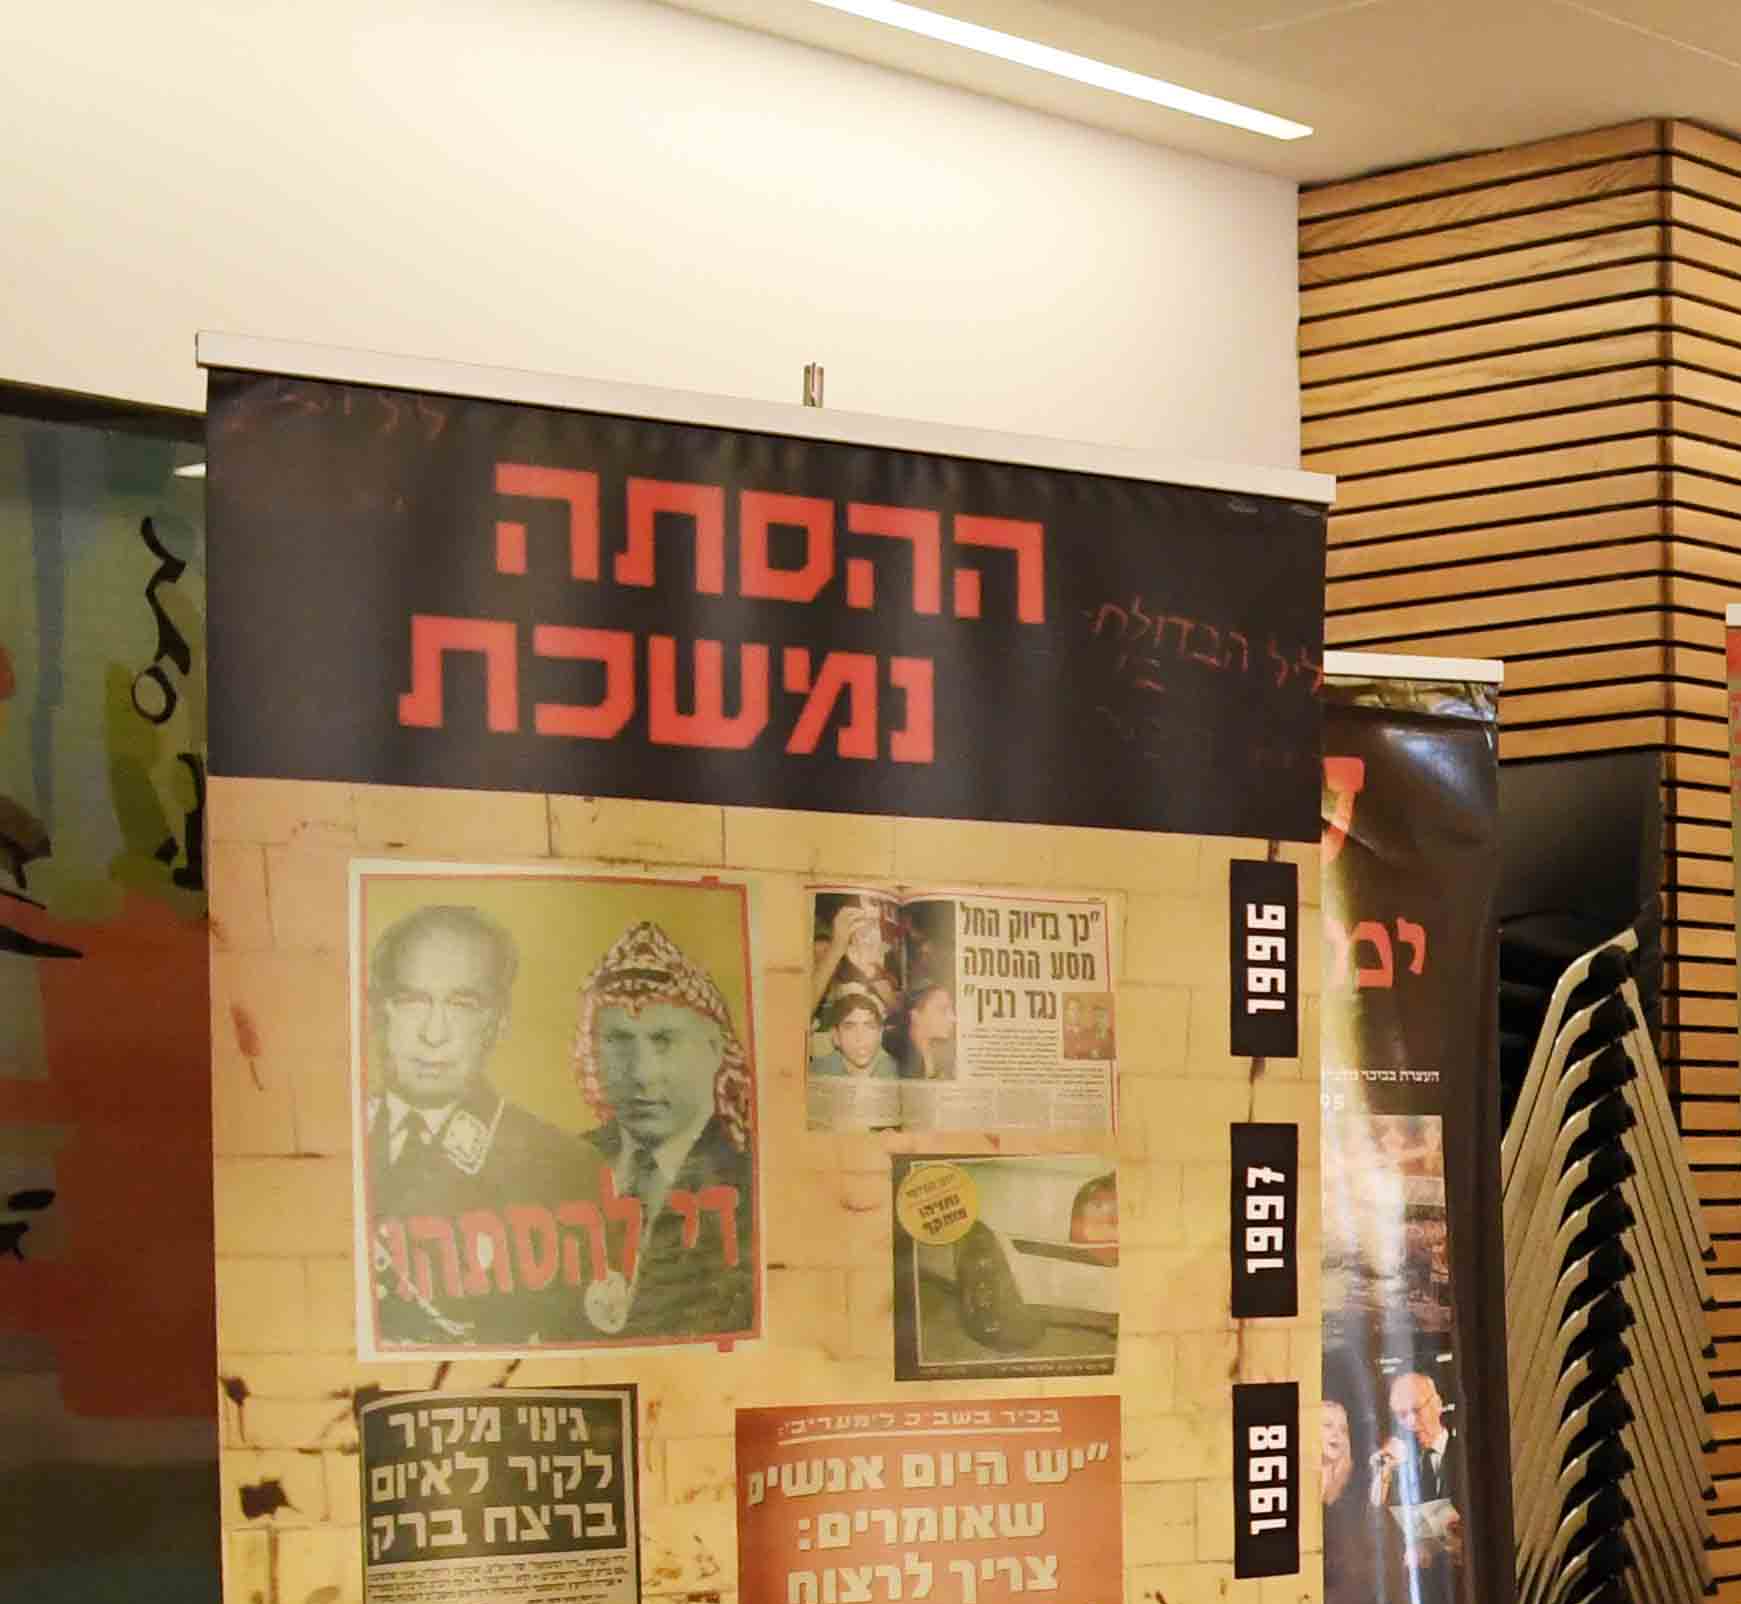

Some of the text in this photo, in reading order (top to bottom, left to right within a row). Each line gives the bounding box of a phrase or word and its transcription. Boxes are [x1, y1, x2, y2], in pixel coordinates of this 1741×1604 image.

[495, 462, 1047, 625] ההסתה
[399, 615, 937, 764] נמשכת
[959, 903, 1061, 942] בדיוק החל
[964, 946, 1095, 981] מסע ההסתה
[1247, 903, 1285, 1014] 1996
[1023, 991, 1057, 1019] נגד
[671, 1185, 739, 1266] די
[1246, 1167, 1285, 1273] 1997
[388, 1407, 501, 1453] מקיר
[371, 1449, 612, 1501] לקיר לאיום
[747, 1450, 1008, 1505] היום אנשים
[1250, 1424, 1288, 1535] 1998
[371, 1503, 617, 1559] ברצח ברק
[797, 1503, 1046, 1551] שאומרים:
[950, 1554, 1059, 1604] צריך
